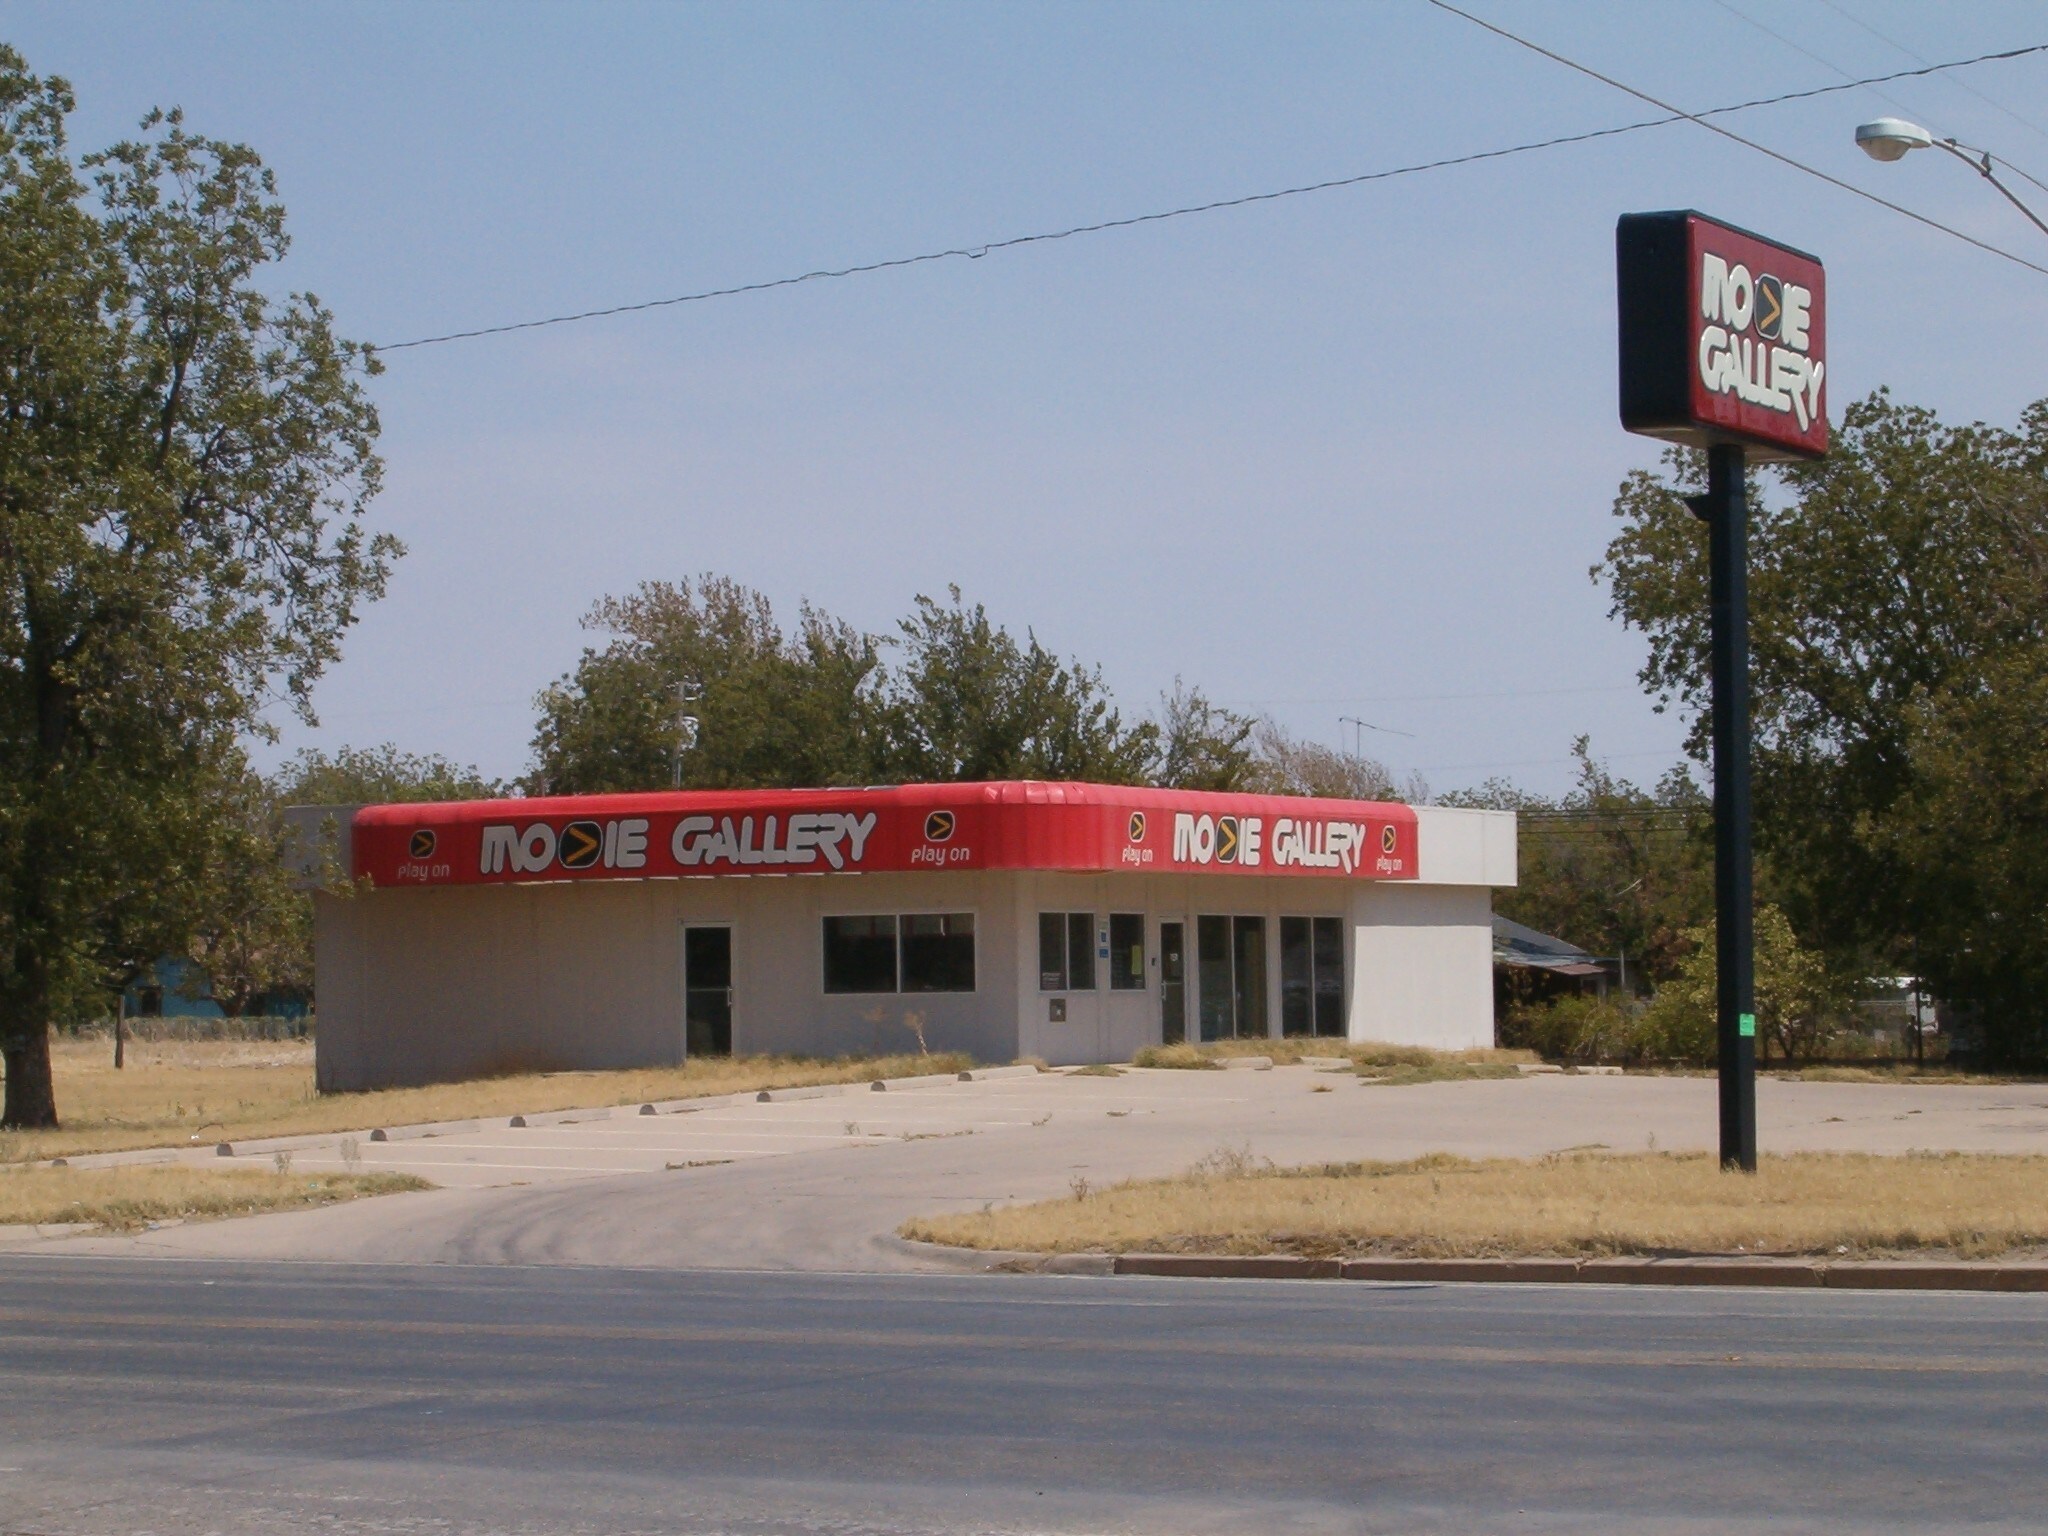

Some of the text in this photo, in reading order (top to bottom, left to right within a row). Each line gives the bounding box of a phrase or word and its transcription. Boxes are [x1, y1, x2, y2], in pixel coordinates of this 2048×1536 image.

[1700, 325, 1825, 432] GALLERY
[671, 812, 877, 869] GALLERY
[911, 844, 970, 866] play on
[1122, 844, 1153, 867] play on
[1271, 818, 1367, 874] GALLERY
[397, 862, 450, 881] play on
